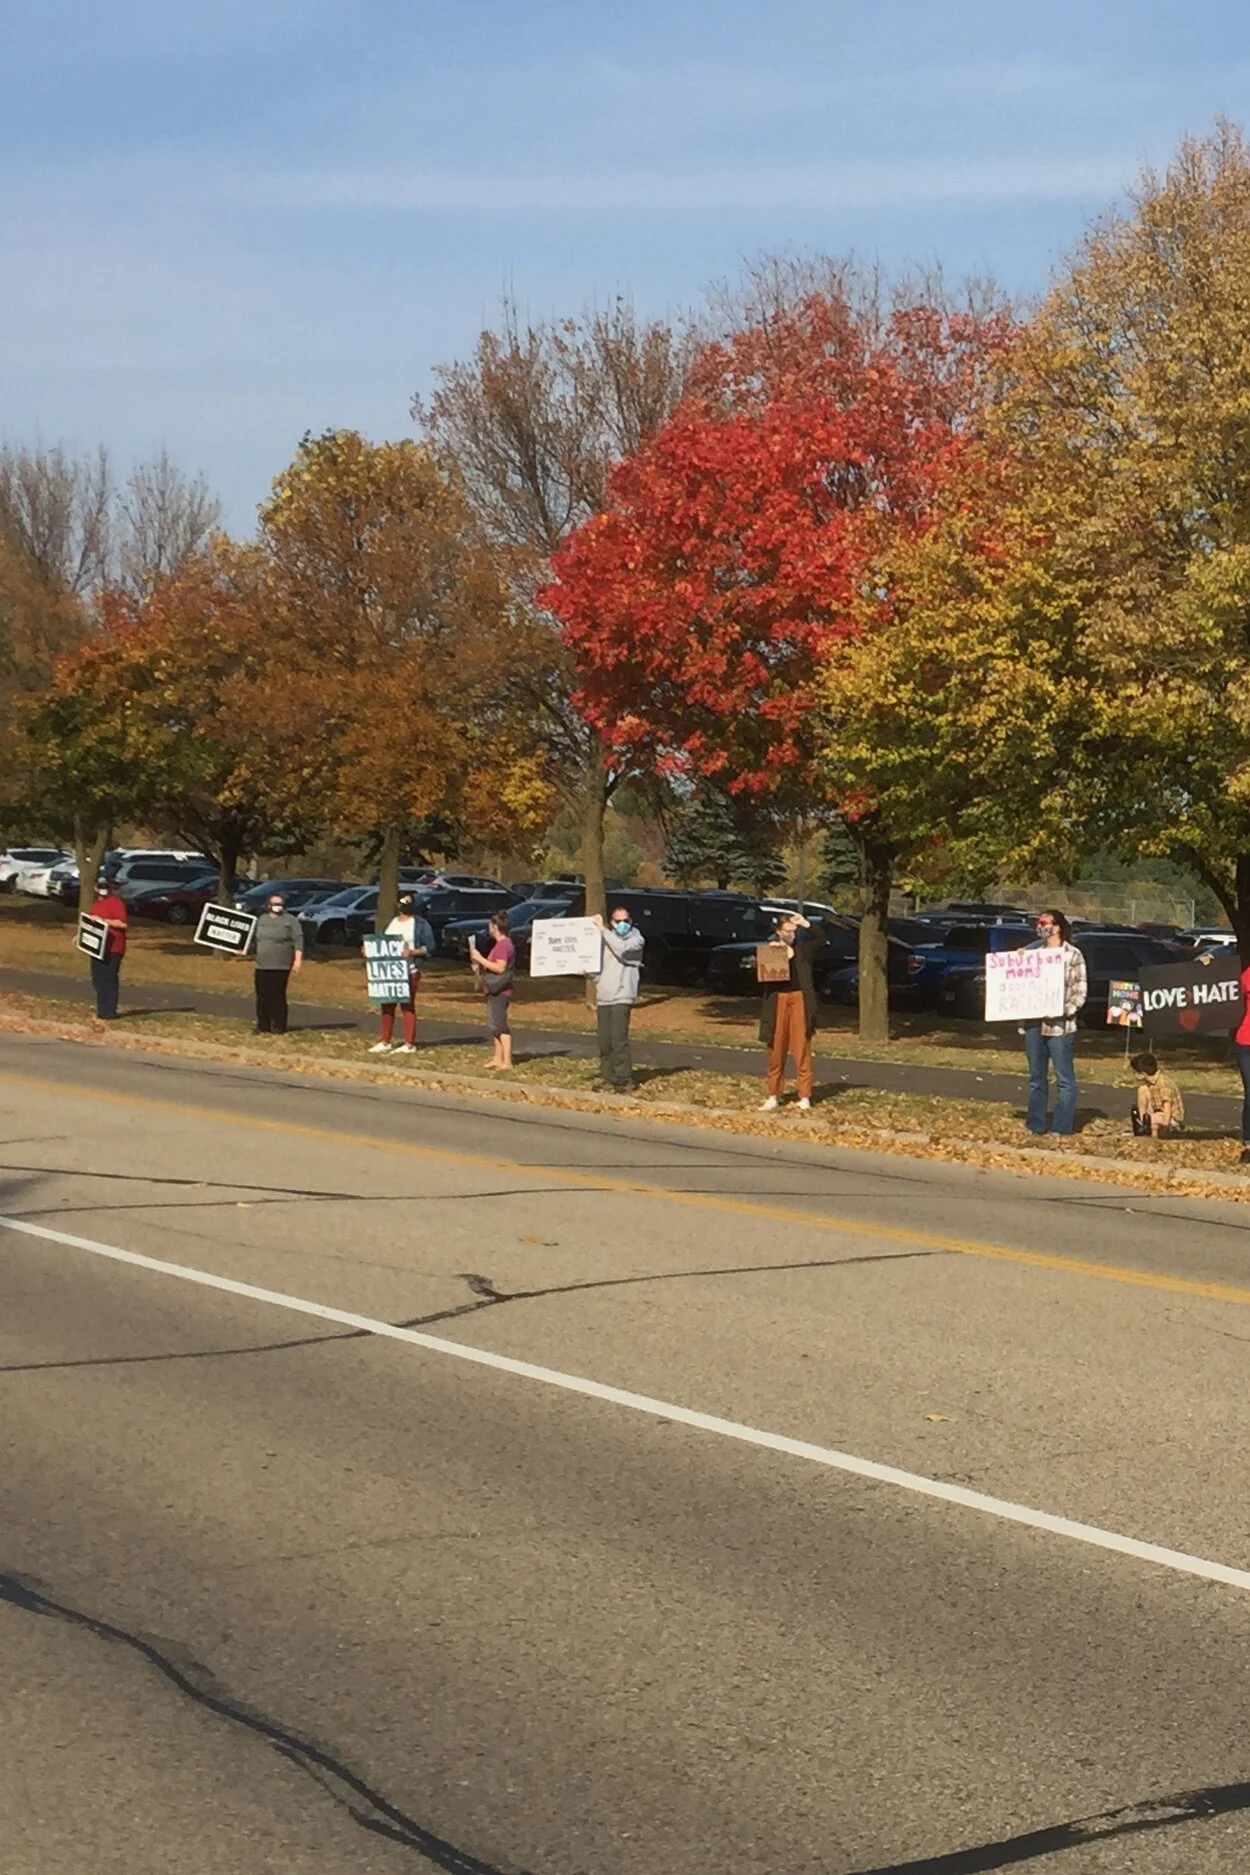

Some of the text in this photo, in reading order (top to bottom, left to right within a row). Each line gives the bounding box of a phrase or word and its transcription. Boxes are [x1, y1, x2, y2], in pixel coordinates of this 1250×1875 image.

[205, 912, 230, 926] BLACK
[363, 940, 405, 957] BLACK
[370, 961, 405, 978] LIVES
[367, 981, 411, 998] MATTER
[1143, 980, 1240, 1011] LOVE HATE
